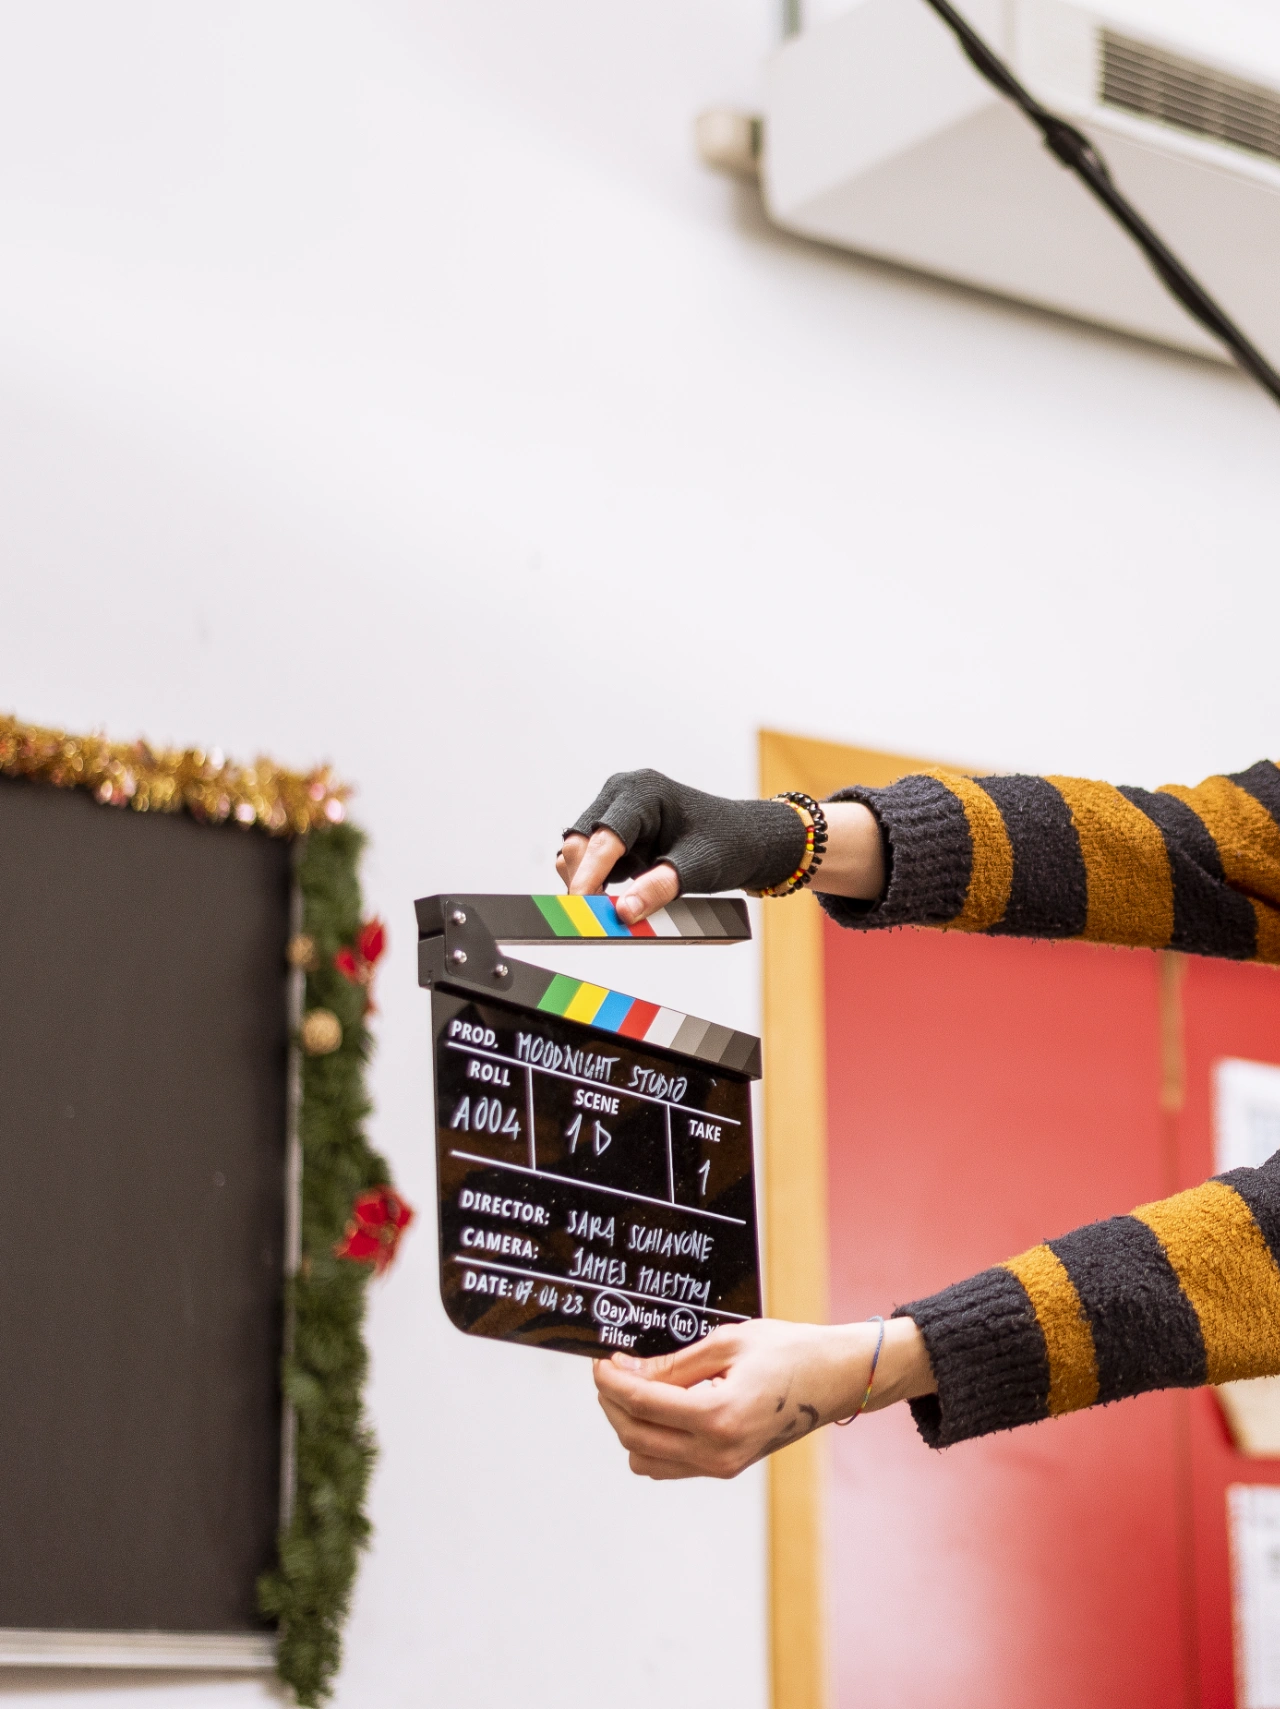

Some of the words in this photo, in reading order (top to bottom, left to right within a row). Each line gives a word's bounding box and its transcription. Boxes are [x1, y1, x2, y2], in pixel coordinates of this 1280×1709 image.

[451, 1020, 499, 1049] PROD.
[469, 1060, 511, 1087] ROLL
[516, 1032, 620, 1083] MOODNIGHT
[627, 1065, 688, 1103] STUDIO
[575, 1089, 620, 1115] SCENE
[452, 1096, 522, 1140] A004
[689, 1119, 722, 1142] TAKE
[698, 1159, 711, 1196] 1
[461, 1189, 551, 1226] DIRECTOR:
[463, 1227, 539, 1260] CAMERA:
[566, 1210, 616, 1247] SARA
[628, 1224, 715, 1263] SCHIAVONE
[568, 1246, 627, 1285] JAMES
[463, 1270, 513, 1297] DATE:
[601, 1326, 638, 1348] Filter
[673, 1314, 693, 1334] Int
[700, 1319, 719, 1337] Ex
